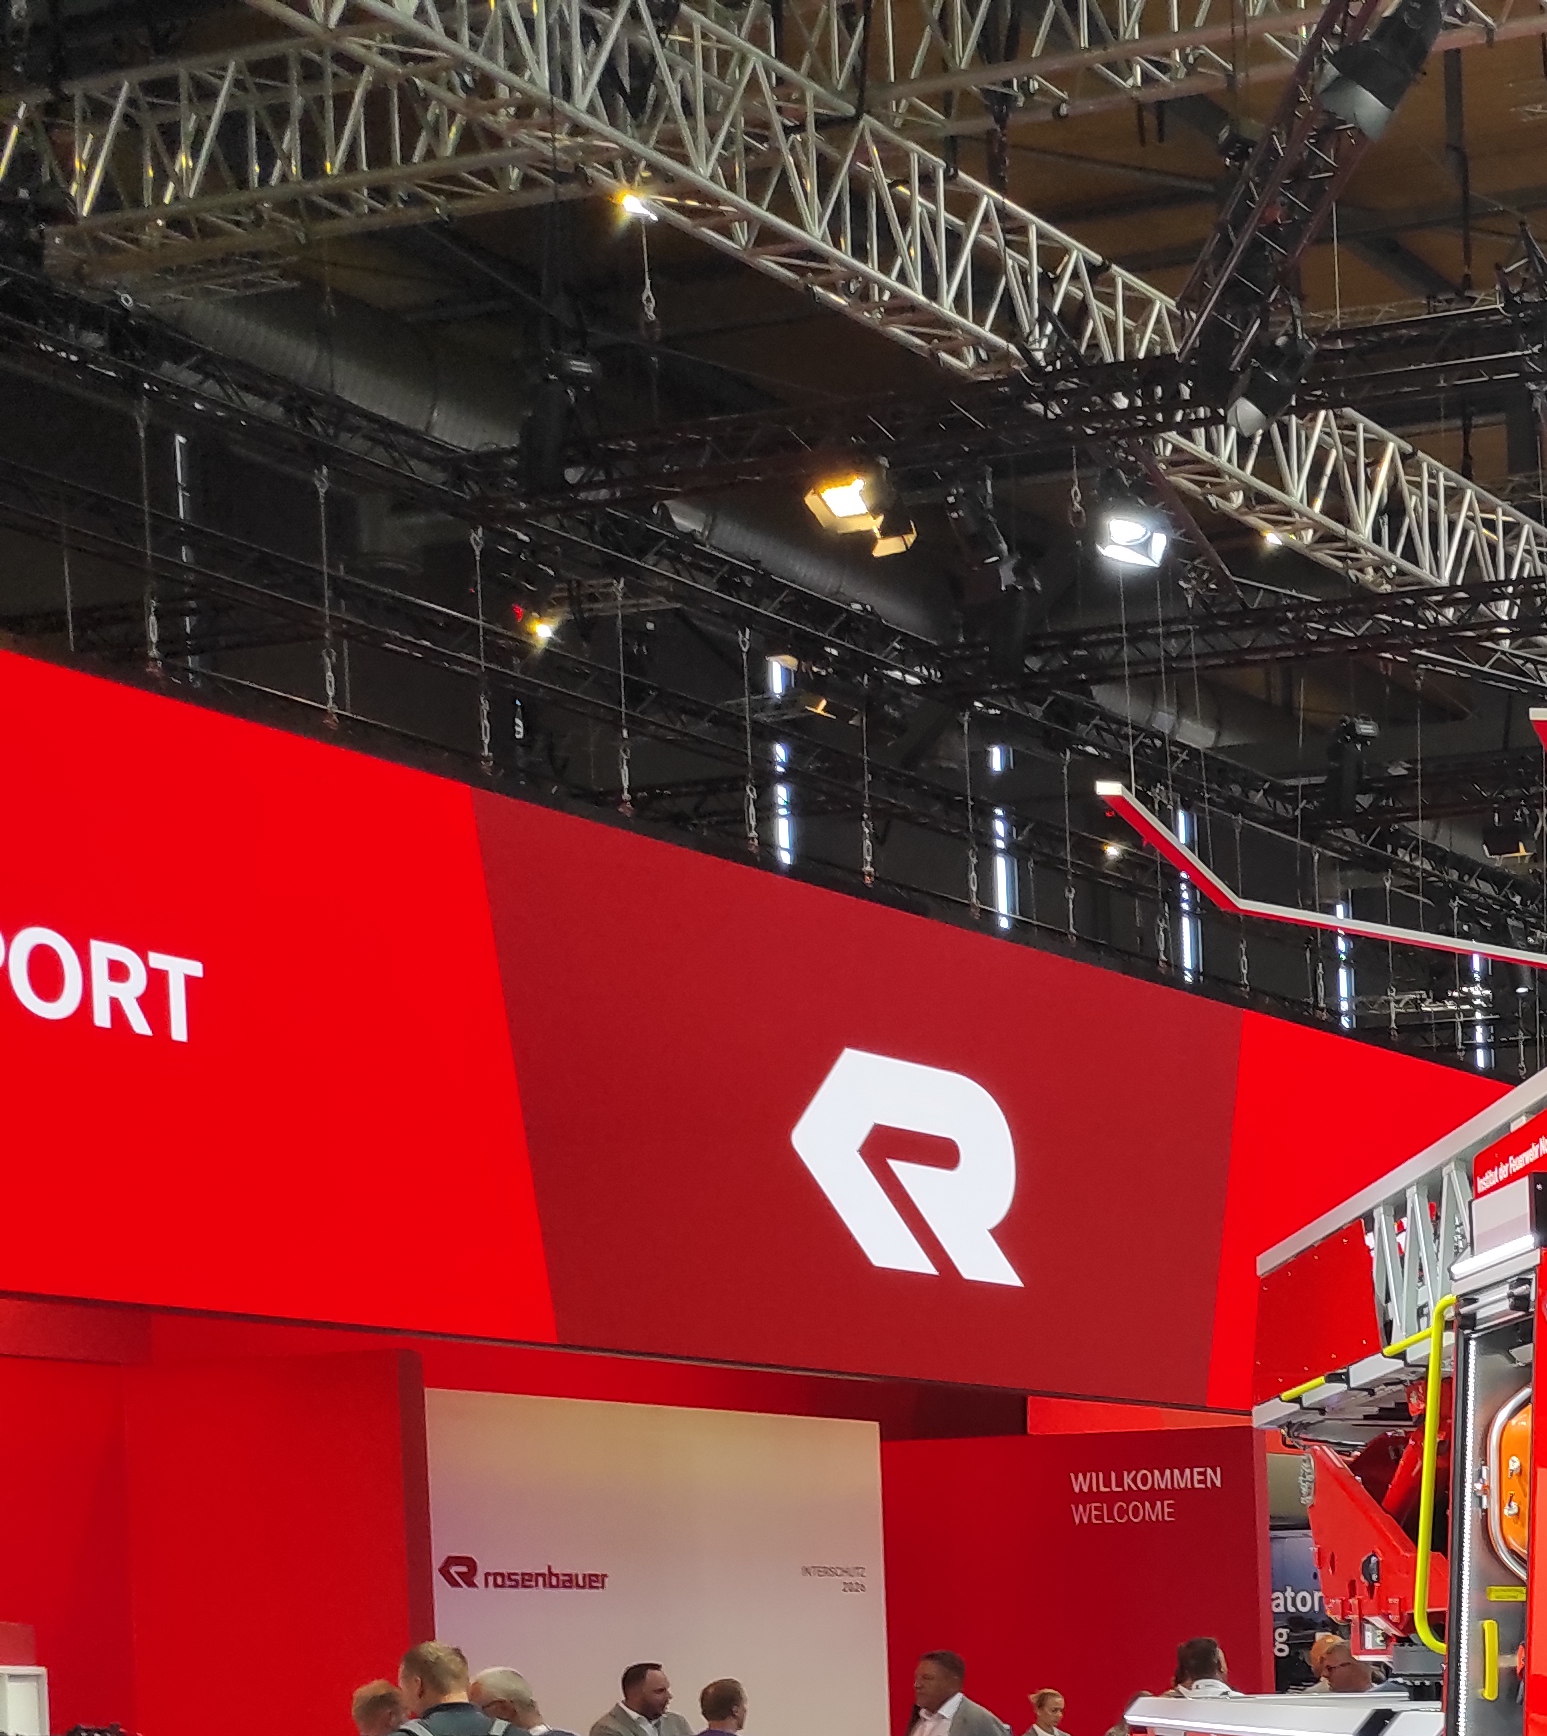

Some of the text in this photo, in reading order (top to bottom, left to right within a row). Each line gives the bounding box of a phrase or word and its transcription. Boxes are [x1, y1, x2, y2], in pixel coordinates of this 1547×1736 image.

[0, 924, 205, 1043] ORT
[1069, 1466, 1223, 1495] WILLKOMMEN
[1071, 1499, 1176, 1525] WELCOME
[483, 1564, 609, 1591] rosenbauer
